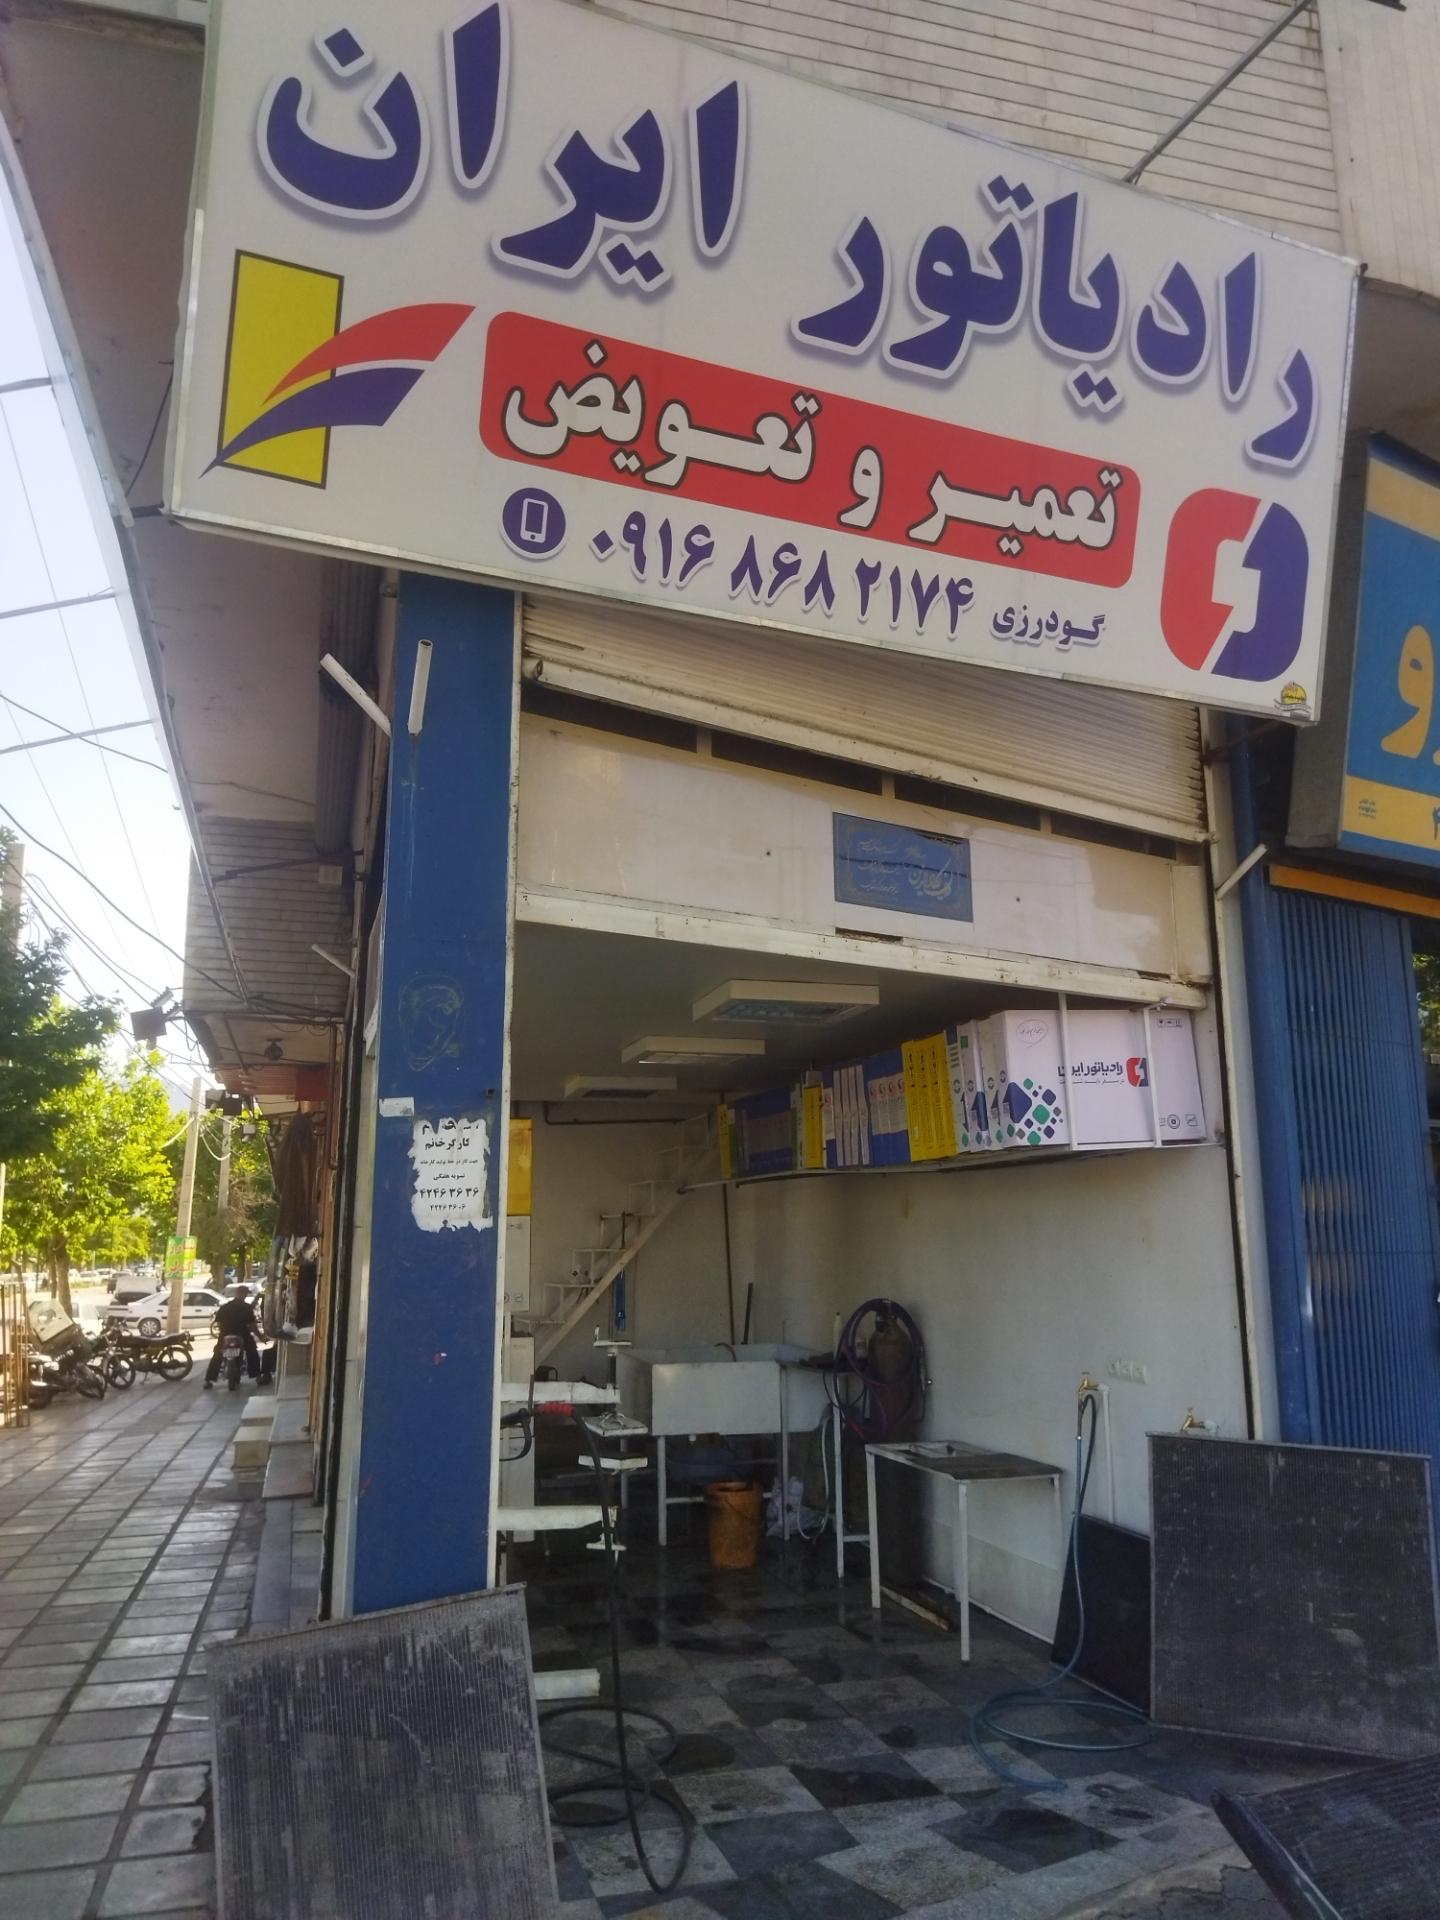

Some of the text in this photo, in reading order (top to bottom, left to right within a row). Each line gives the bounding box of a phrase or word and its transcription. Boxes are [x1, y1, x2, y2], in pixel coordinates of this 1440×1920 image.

[258, 1, 1320, 466] رادیاتور ایران
[503, 339, 1122, 556] تعمیر و تعویض
[590, 509, 976, 636] ۰۹۱۶ ۸۶۸ ۲۱۷۴
[991, 604, 1107, 646] گودرزی
[1086, 1061, 1123, 1077] رادیاتور
